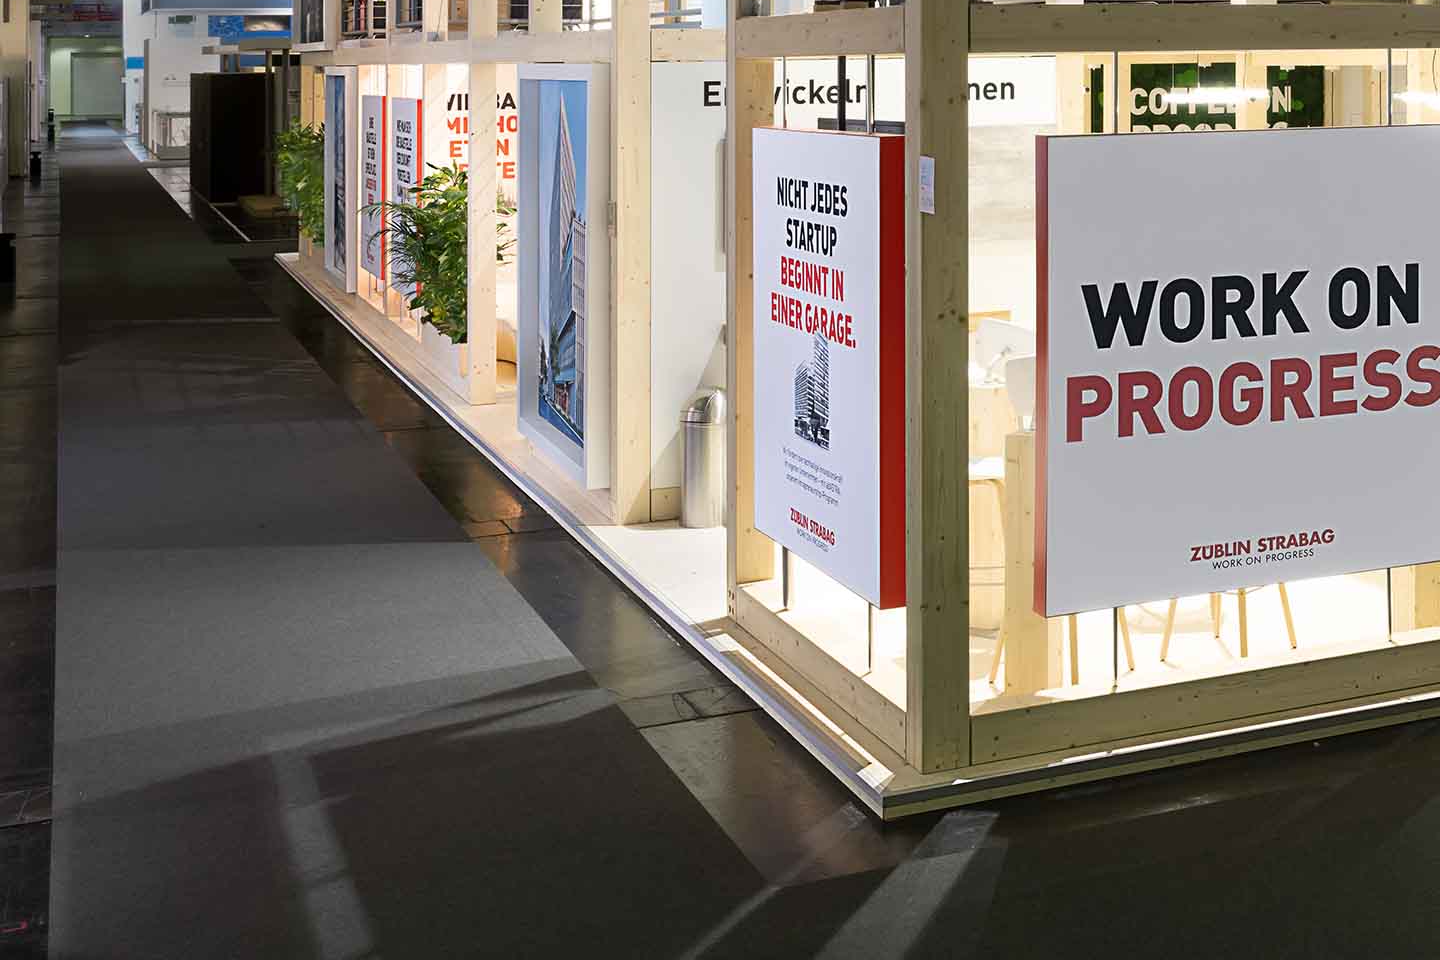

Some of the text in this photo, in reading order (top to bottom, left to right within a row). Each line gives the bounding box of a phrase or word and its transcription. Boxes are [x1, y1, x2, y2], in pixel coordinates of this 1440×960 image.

[776, 176, 848, 218] NICHT JEDES
[786, 217, 837, 257] STARTUP
[780, 255, 845, 303] BEGINNT IN
[771, 291, 857, 349] EINER GARAGE.
[1081, 262, 1420, 349] WORK ON
[1190, 527, 1336, 562] ZÜBLIN STRABAG
[1212, 548, 1315, 569] WORK ON PROGRESS
